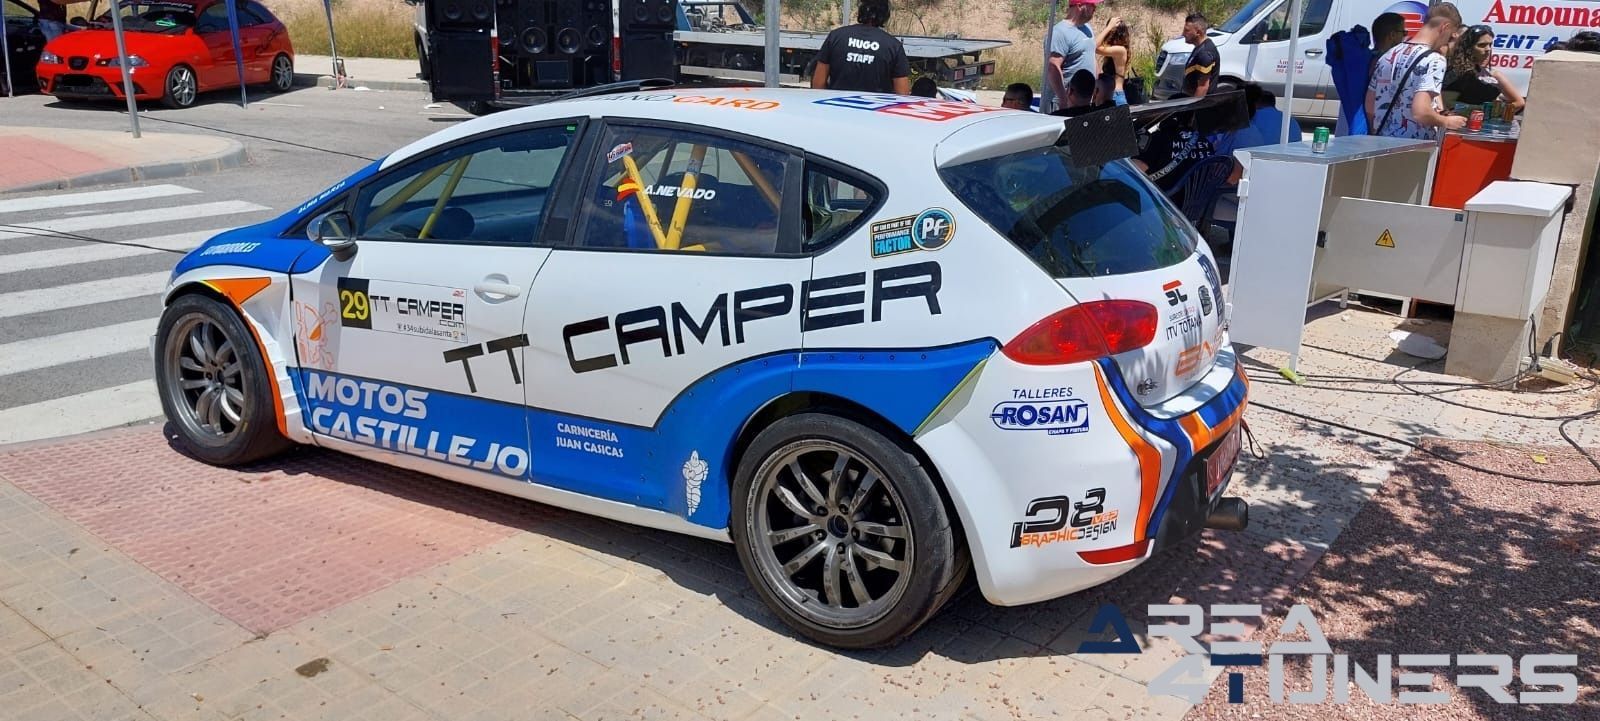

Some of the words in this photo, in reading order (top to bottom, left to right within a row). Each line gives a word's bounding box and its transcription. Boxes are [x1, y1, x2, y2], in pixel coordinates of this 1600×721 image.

[848, 37, 880, 51] HUGO
[1493, 34, 1540, 49] ENT
[846, 52, 875, 65] STAFF
[1491, 54, 1519, 68] 968
[1523, 56, 1534, 68] 2
[1172, 141, 1209, 149] MICEY
[644, 184, 716, 201] A.NEVADO
[874, 228, 910, 240] PERFORMANCE
[875, 235, 912, 255] FACTOR
[340, 290, 369, 321] 29
[369, 295, 390, 313] TT
[397, 297, 465, 321] CAMPER
[443, 333, 530, 393] TT
[562, 261, 943, 374] CAMPER
[1166, 325, 1178, 340] ITV
[308, 373, 430, 419] MOTOS
[1012, 387, 1073, 400] TALLERES
[1000, 404, 1080, 426] ROSAN
[557, 422, 619, 443] CARNICERÍA
[312, 407, 529, 477] CASTILLEJO
[556, 436, 582, 450] JUAN
[583, 441, 624, 458] CASICAS
